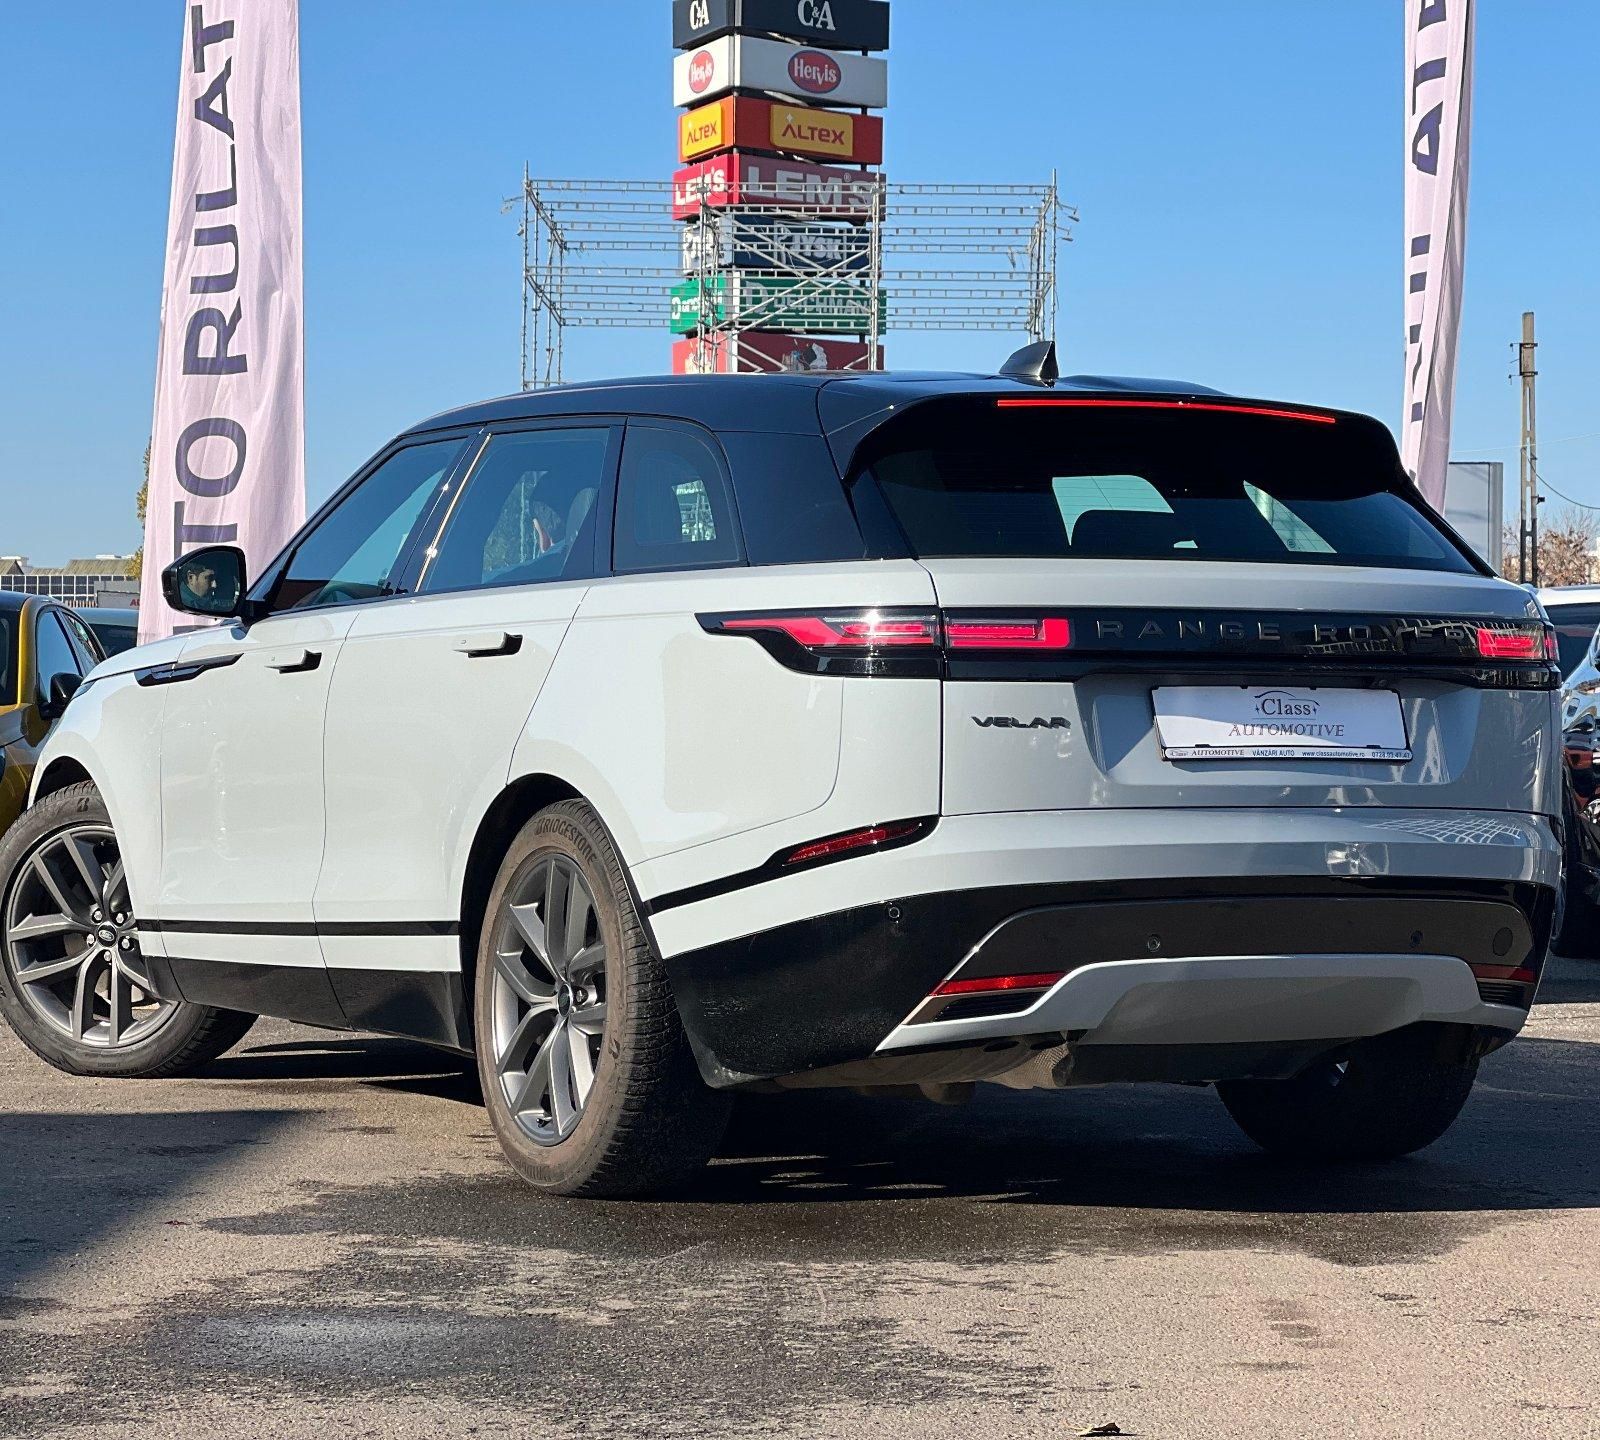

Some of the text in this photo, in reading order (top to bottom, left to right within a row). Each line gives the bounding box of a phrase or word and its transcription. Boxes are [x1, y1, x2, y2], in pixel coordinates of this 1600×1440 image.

[797, 0, 836, 31] C&A
[793, 56, 837, 85] Hervis
[1096, 619, 1281, 641] RANGE
[1261, 697, 1311, 716] Class
[971, 716, 1072, 729] VELAR
[1228, 722, 1345, 737] AUTOMOTIVE
[1191, 749, 1245, 757] AUTOMOTIVE
